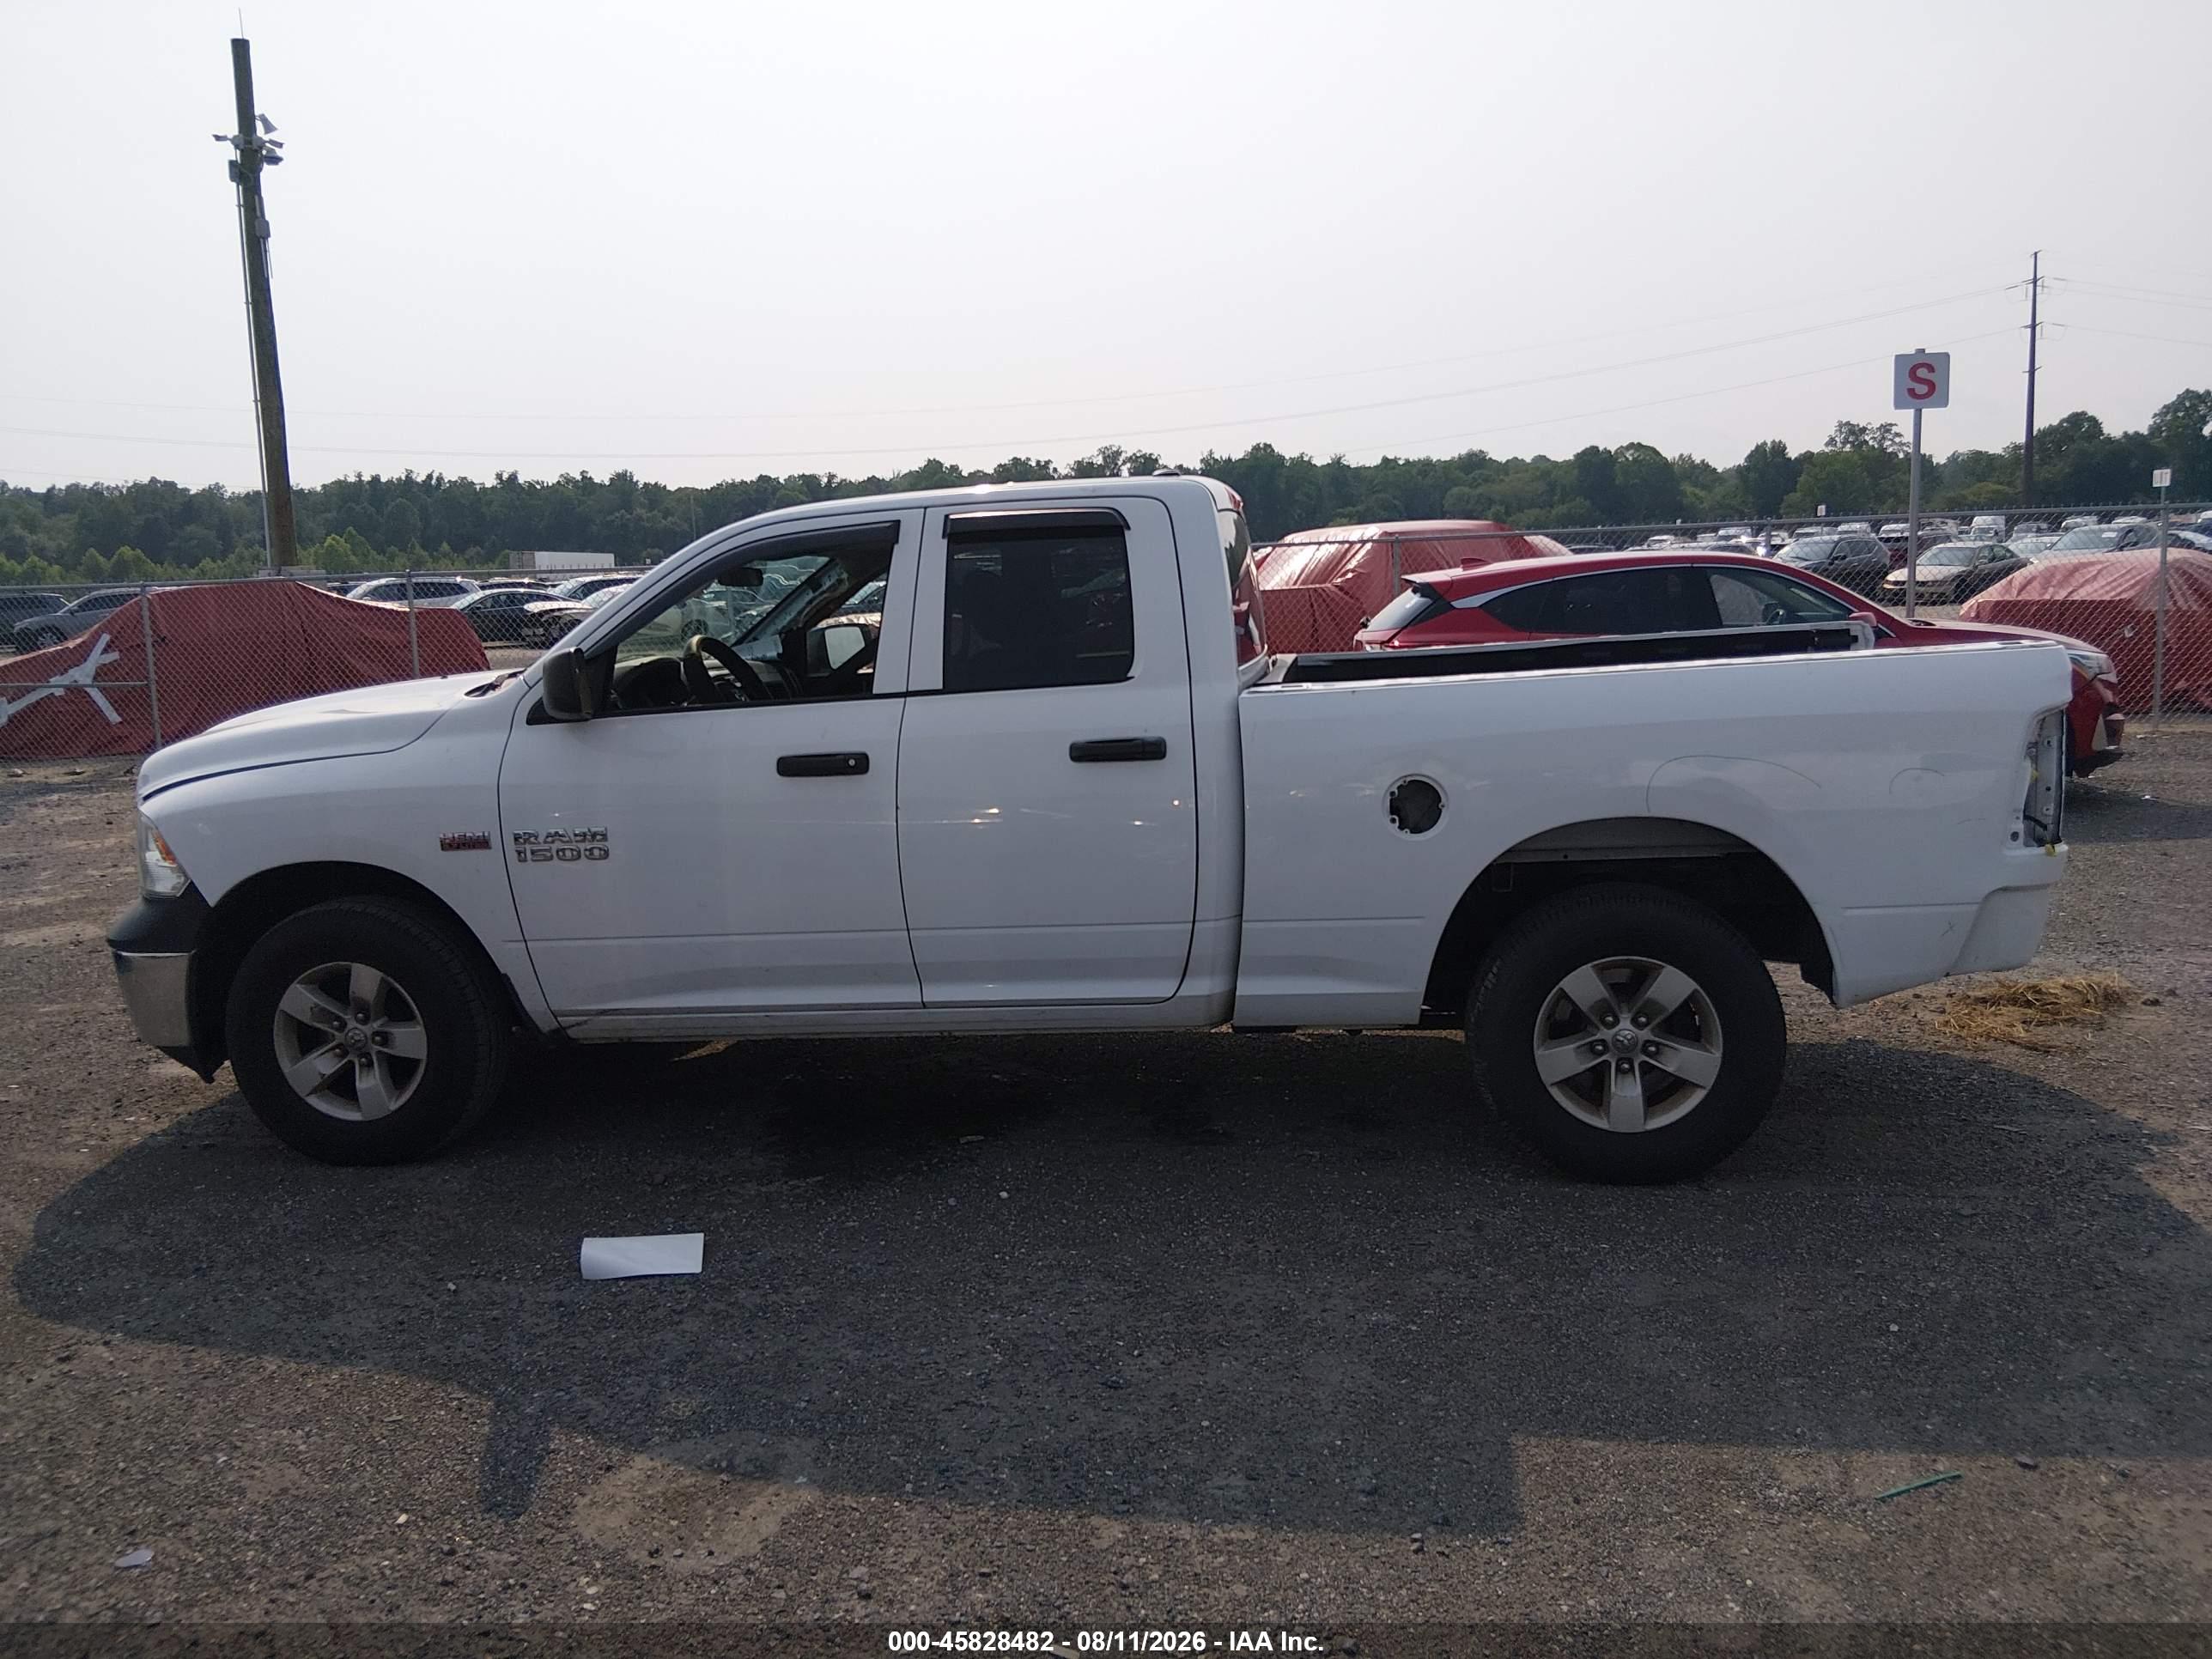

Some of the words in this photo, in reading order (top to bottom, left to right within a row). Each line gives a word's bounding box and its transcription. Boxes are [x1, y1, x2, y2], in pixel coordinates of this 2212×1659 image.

[1907, 362, 1936, 400] S
[513, 828, 609, 845] RAM
[515, 845, 610, 863] 1500
